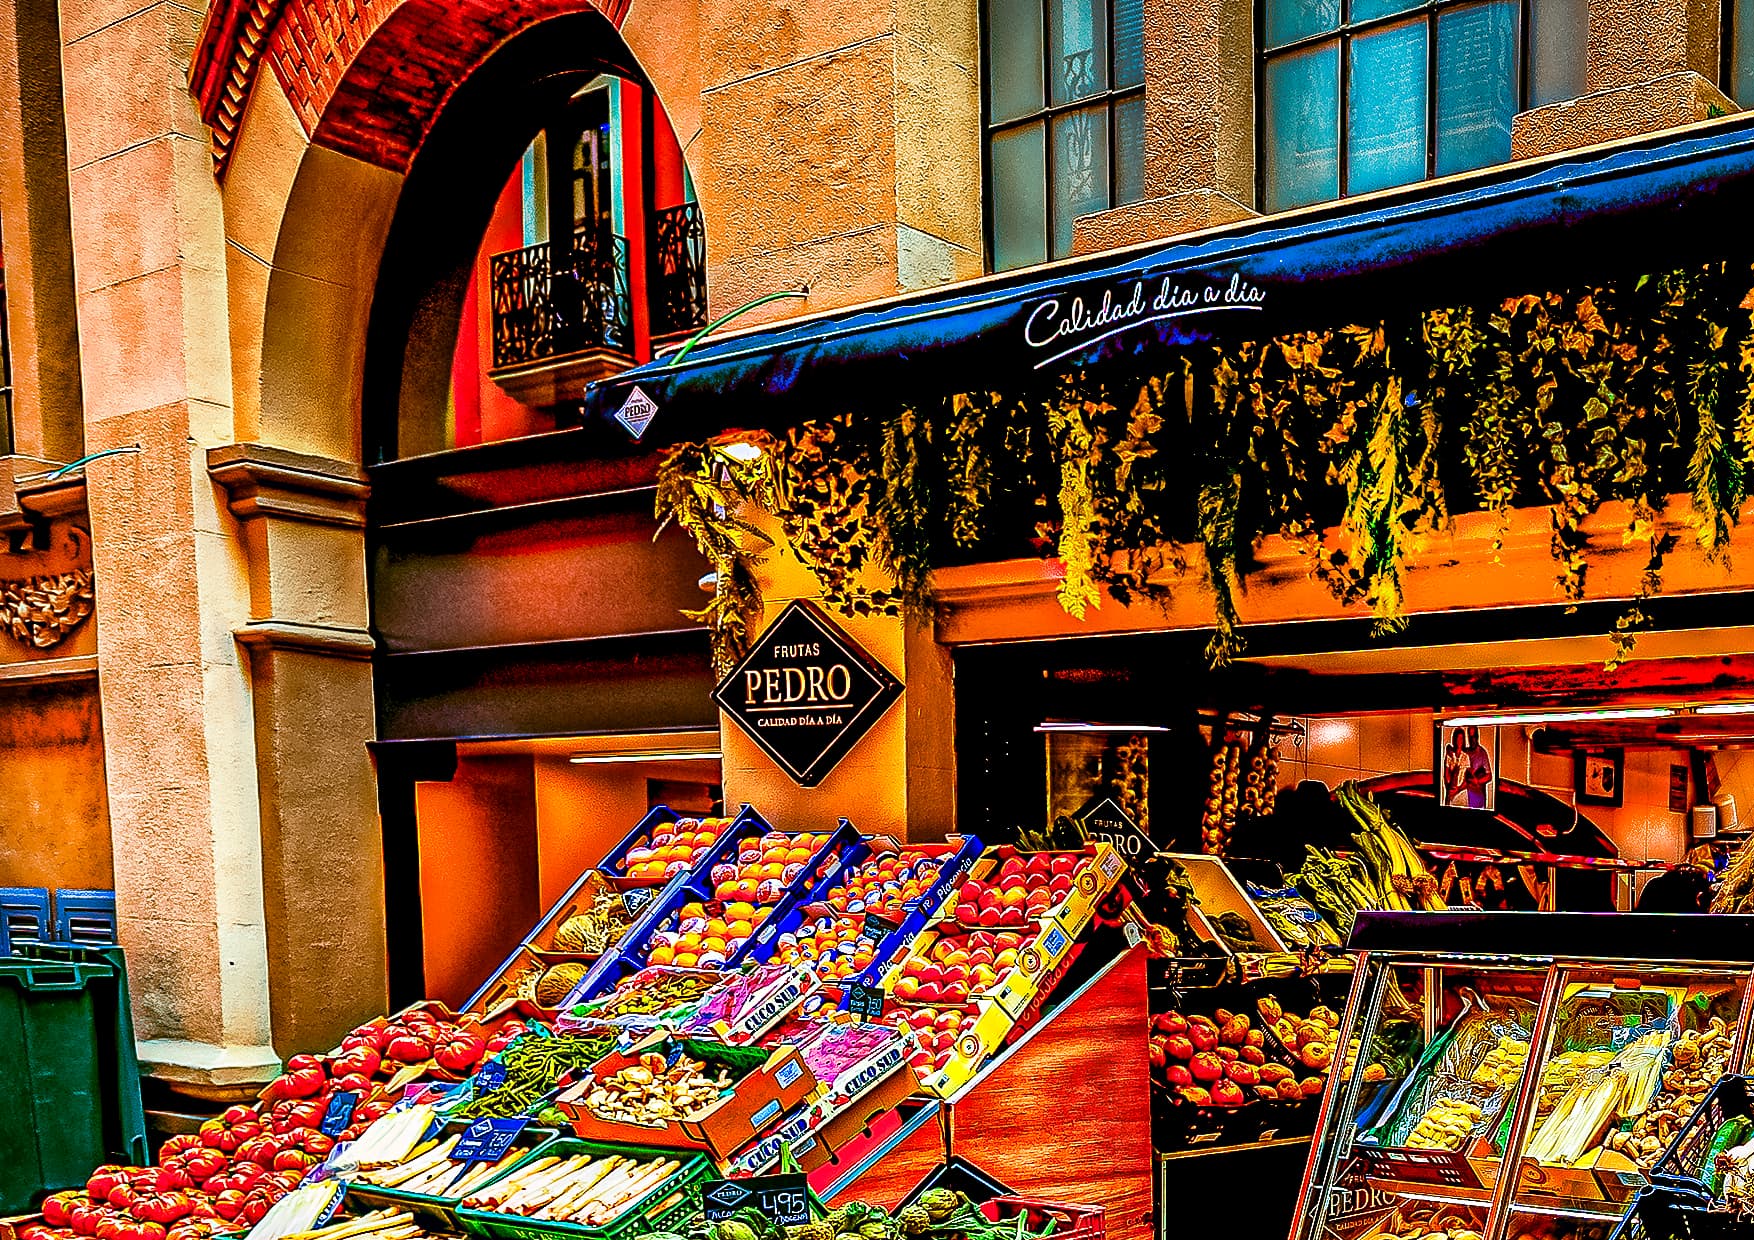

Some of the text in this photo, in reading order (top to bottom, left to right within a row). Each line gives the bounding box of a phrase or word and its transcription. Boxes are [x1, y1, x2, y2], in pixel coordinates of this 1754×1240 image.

[1024, 281, 1146, 347] Calidad
[1204, 286, 1220, 302] a
[774, 642, 820, 658] FRUTAS
[744, 664, 851, 704] PEDRO
[757, 717, 798, 727] CALIDAD
[816, 716, 824, 725] A
[744, 984, 800, 1032] CUCO SUD
[844, 1048, 901, 1094] CUCO SUD
[747, 1137, 781, 1169] CUCO
[782, 1118, 808, 1141] SUD
